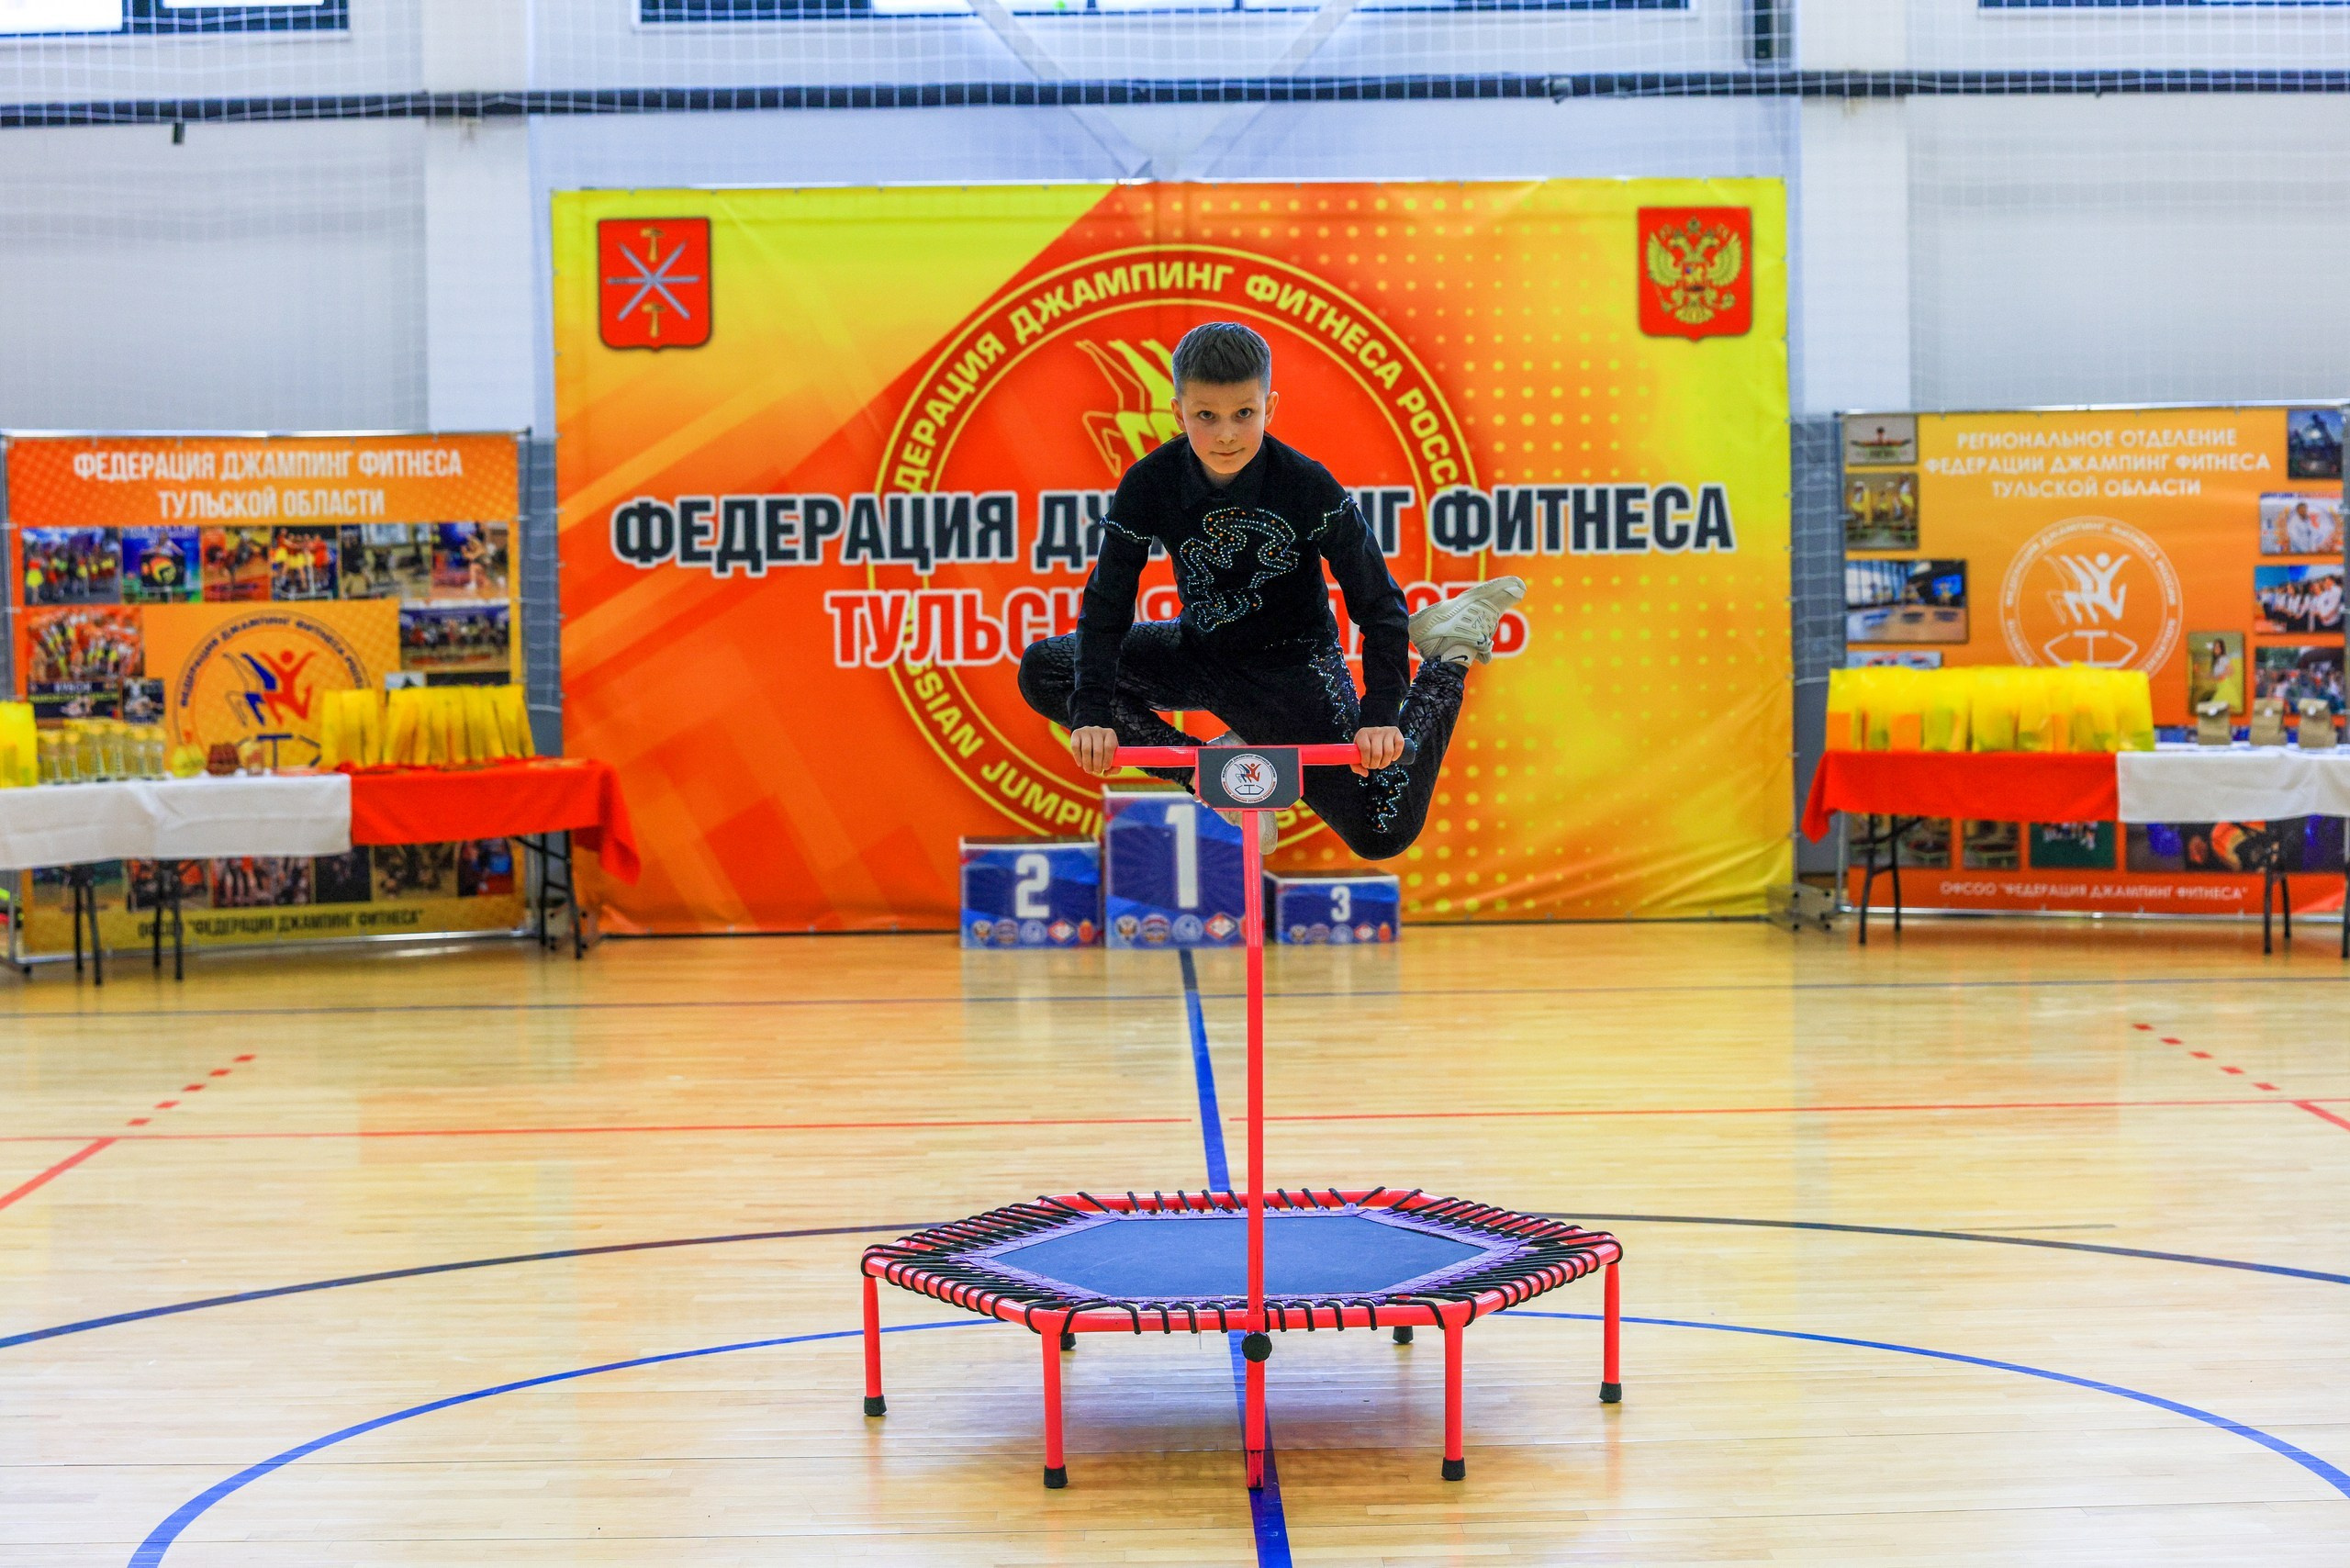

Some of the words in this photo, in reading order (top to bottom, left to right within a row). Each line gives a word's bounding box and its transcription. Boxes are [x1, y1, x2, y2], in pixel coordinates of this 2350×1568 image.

[1009, 261, 1235, 345] ДЖАМПИНГ
[1245, 274, 1404, 391] ФИТНЕСА
[1396, 386, 1461, 490] РОСС
[1956, 430, 2113, 450] РЕГИОНАЛЬНОЕ
[2120, 428, 2237, 448] ОТДЕЛЕНИЕ
[73, 451, 215, 482] ФЕДЕРАЦИЯ
[219, 449, 352, 481] ДЖАМПИНГ
[358, 448, 463, 477] ФИТНЕСА
[2049, 454, 2169, 475] ДЖАМПИНГ
[2175, 452, 2271, 472] ФИТНЕСА
[157, 487, 275, 520] ТУЛЬСКОЙ
[282, 488, 386, 518] ОБЛАСТИ
[1992, 476, 2098, 498] ТУЛЬСКОЙ
[2104, 477, 2201, 498] ОБЛАСТИ
[613, 493, 1017, 577] ФЕДЕРАЦИЯ
[1429, 485, 1736, 555] ФИТНЕСА
[1165, 803, 1199, 909] 1
[1015, 853, 1050, 919] 2
[1331, 885, 1351, 922] 3
